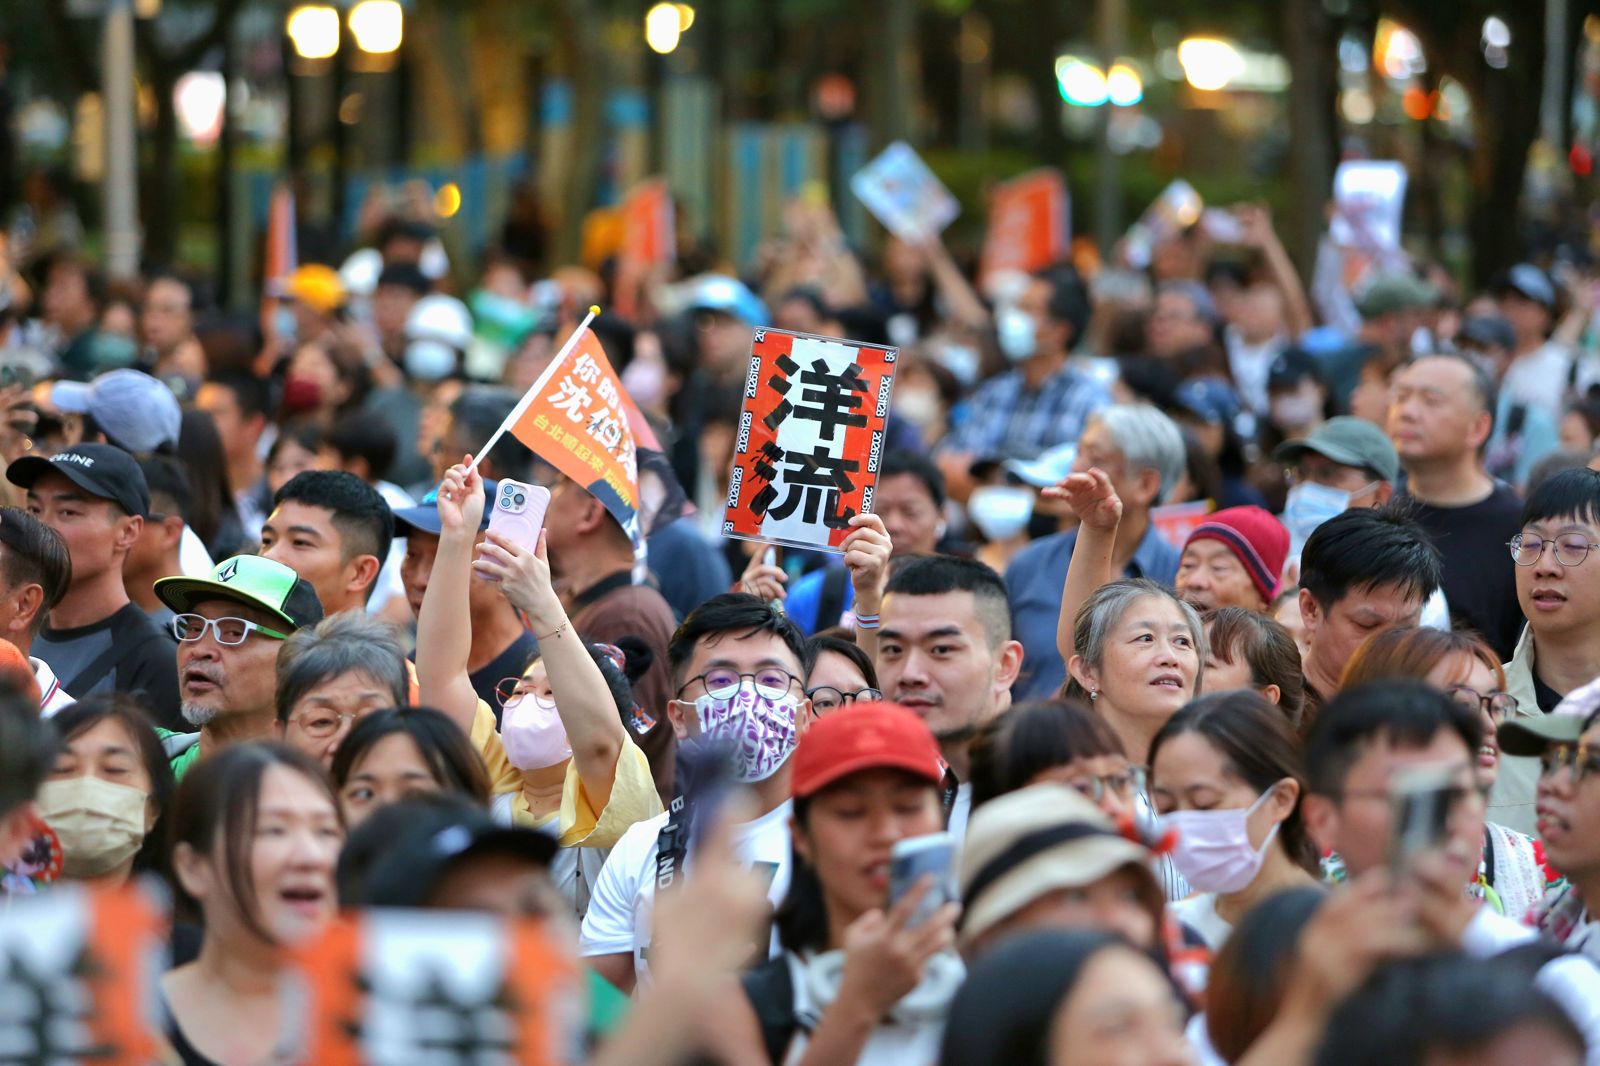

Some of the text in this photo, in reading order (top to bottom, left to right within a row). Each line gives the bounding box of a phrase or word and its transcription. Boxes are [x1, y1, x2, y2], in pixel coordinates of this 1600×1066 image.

[746, 356, 761, 398] 20261128
[876, 375, 891, 417] 20261128
[737, 411, 752, 453] 20261128
[748, 352, 870, 529] 洋流
[867, 430, 882, 473] 20261128
[728, 466, 743, 508] 20261128
